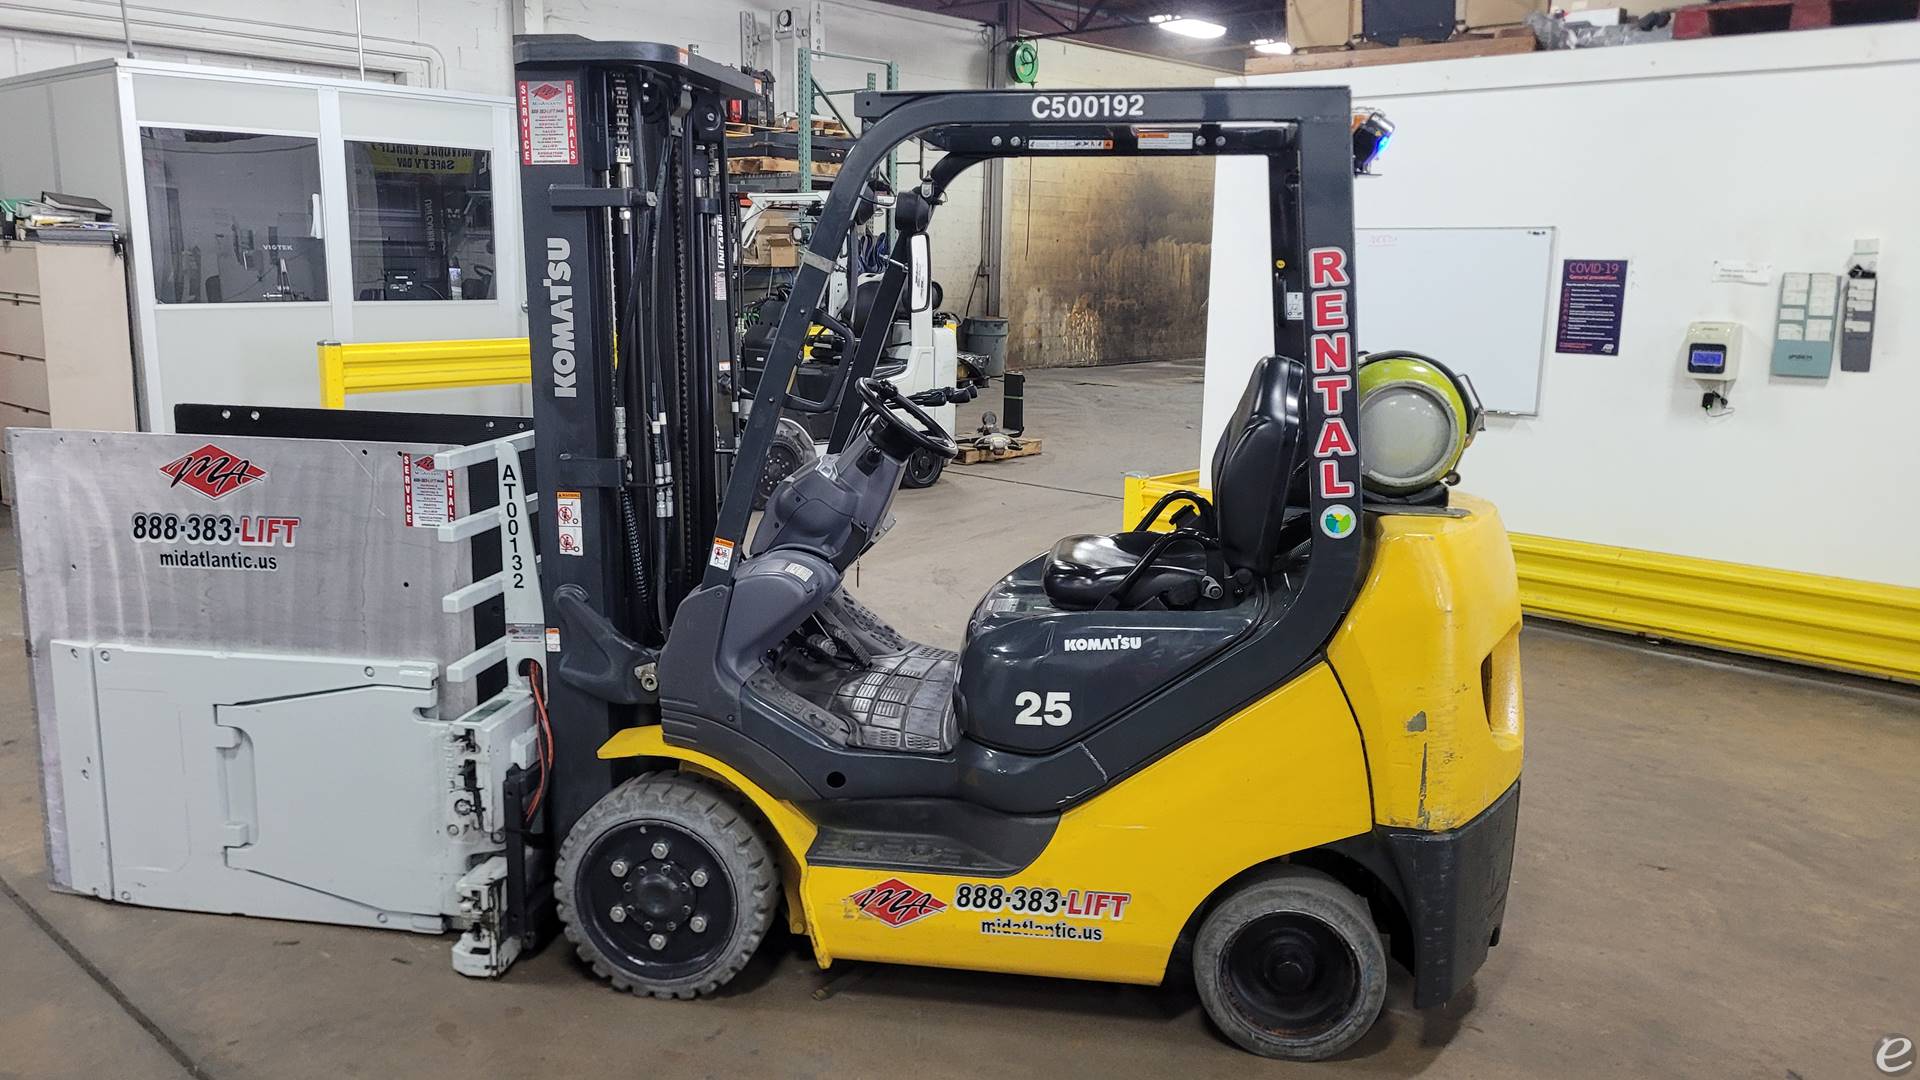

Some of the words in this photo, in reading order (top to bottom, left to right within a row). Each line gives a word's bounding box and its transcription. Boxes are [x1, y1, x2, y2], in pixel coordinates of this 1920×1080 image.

[520, 85, 531, 161] SERVICE
[566, 84, 576, 160] RENTALS
[1031, 95, 1145, 119] C500192
[1569, 262, 1619, 275] COVID-19
[542, 237, 577, 398] KOMATSU
[1311, 249, 1356, 496] RENTAL
[403, 455, 413, 523] SERVICE
[159, 549, 278, 571] midatlantic.us
[502, 464, 525, 589] AT00132
[1064, 635, 1142, 651] KOMATSU
[1015, 691, 1073, 727] 25
